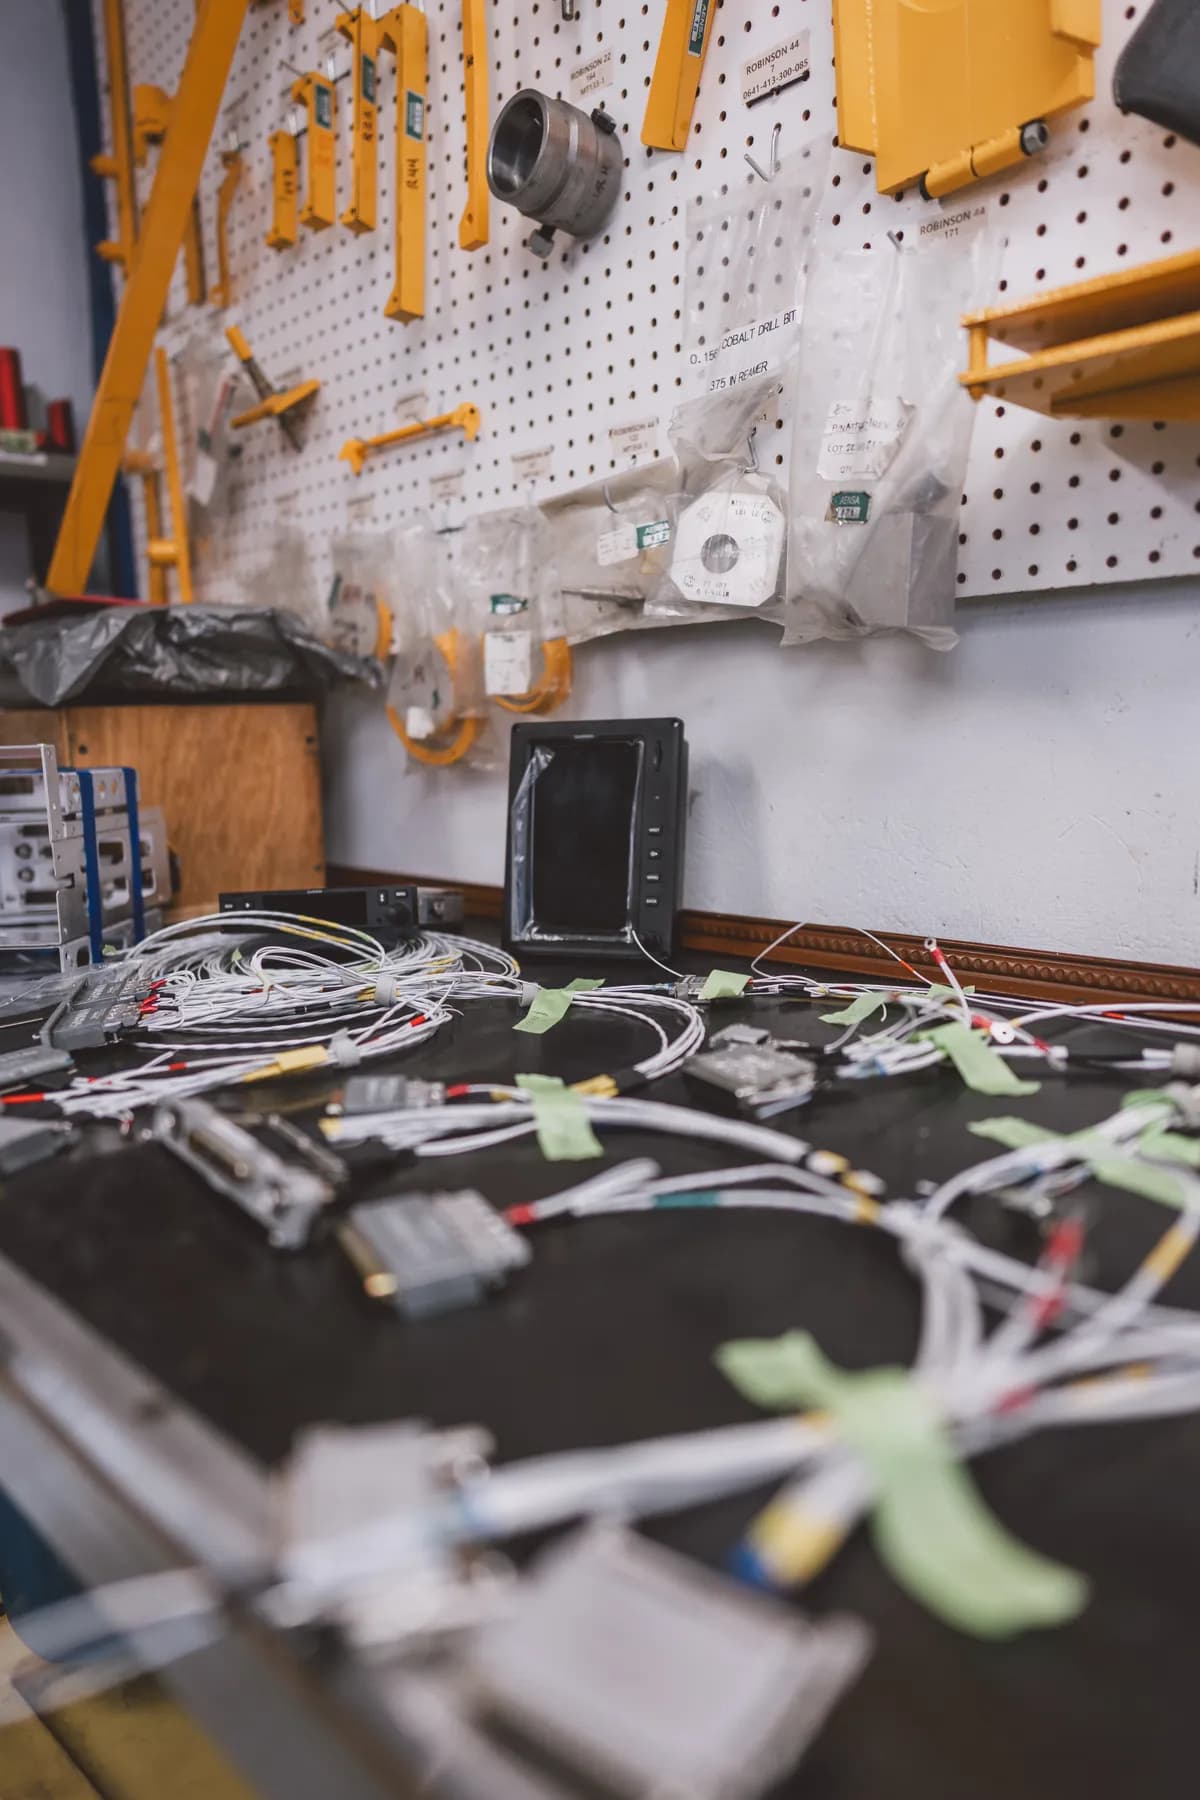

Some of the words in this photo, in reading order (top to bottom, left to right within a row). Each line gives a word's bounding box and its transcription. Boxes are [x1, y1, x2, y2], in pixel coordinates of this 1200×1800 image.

[697, 4, 707, 40] AENSA
[570, 57, 603, 81] ROBINSON
[745, 46, 788, 76] ROBINSON
[789, 39, 801, 51] 44
[770, 63, 776, 73] 7
[742, 58, 809, 100] 0641-413-300-085
[920, 210, 971, 236] ROBINSON
[973, 206, 986, 217] 44
[944, 227, 960, 239] 171
[721, 327, 756, 350] COBALT
[757, 318, 780, 337] DRILL
[783, 309, 797, 326] BIT
